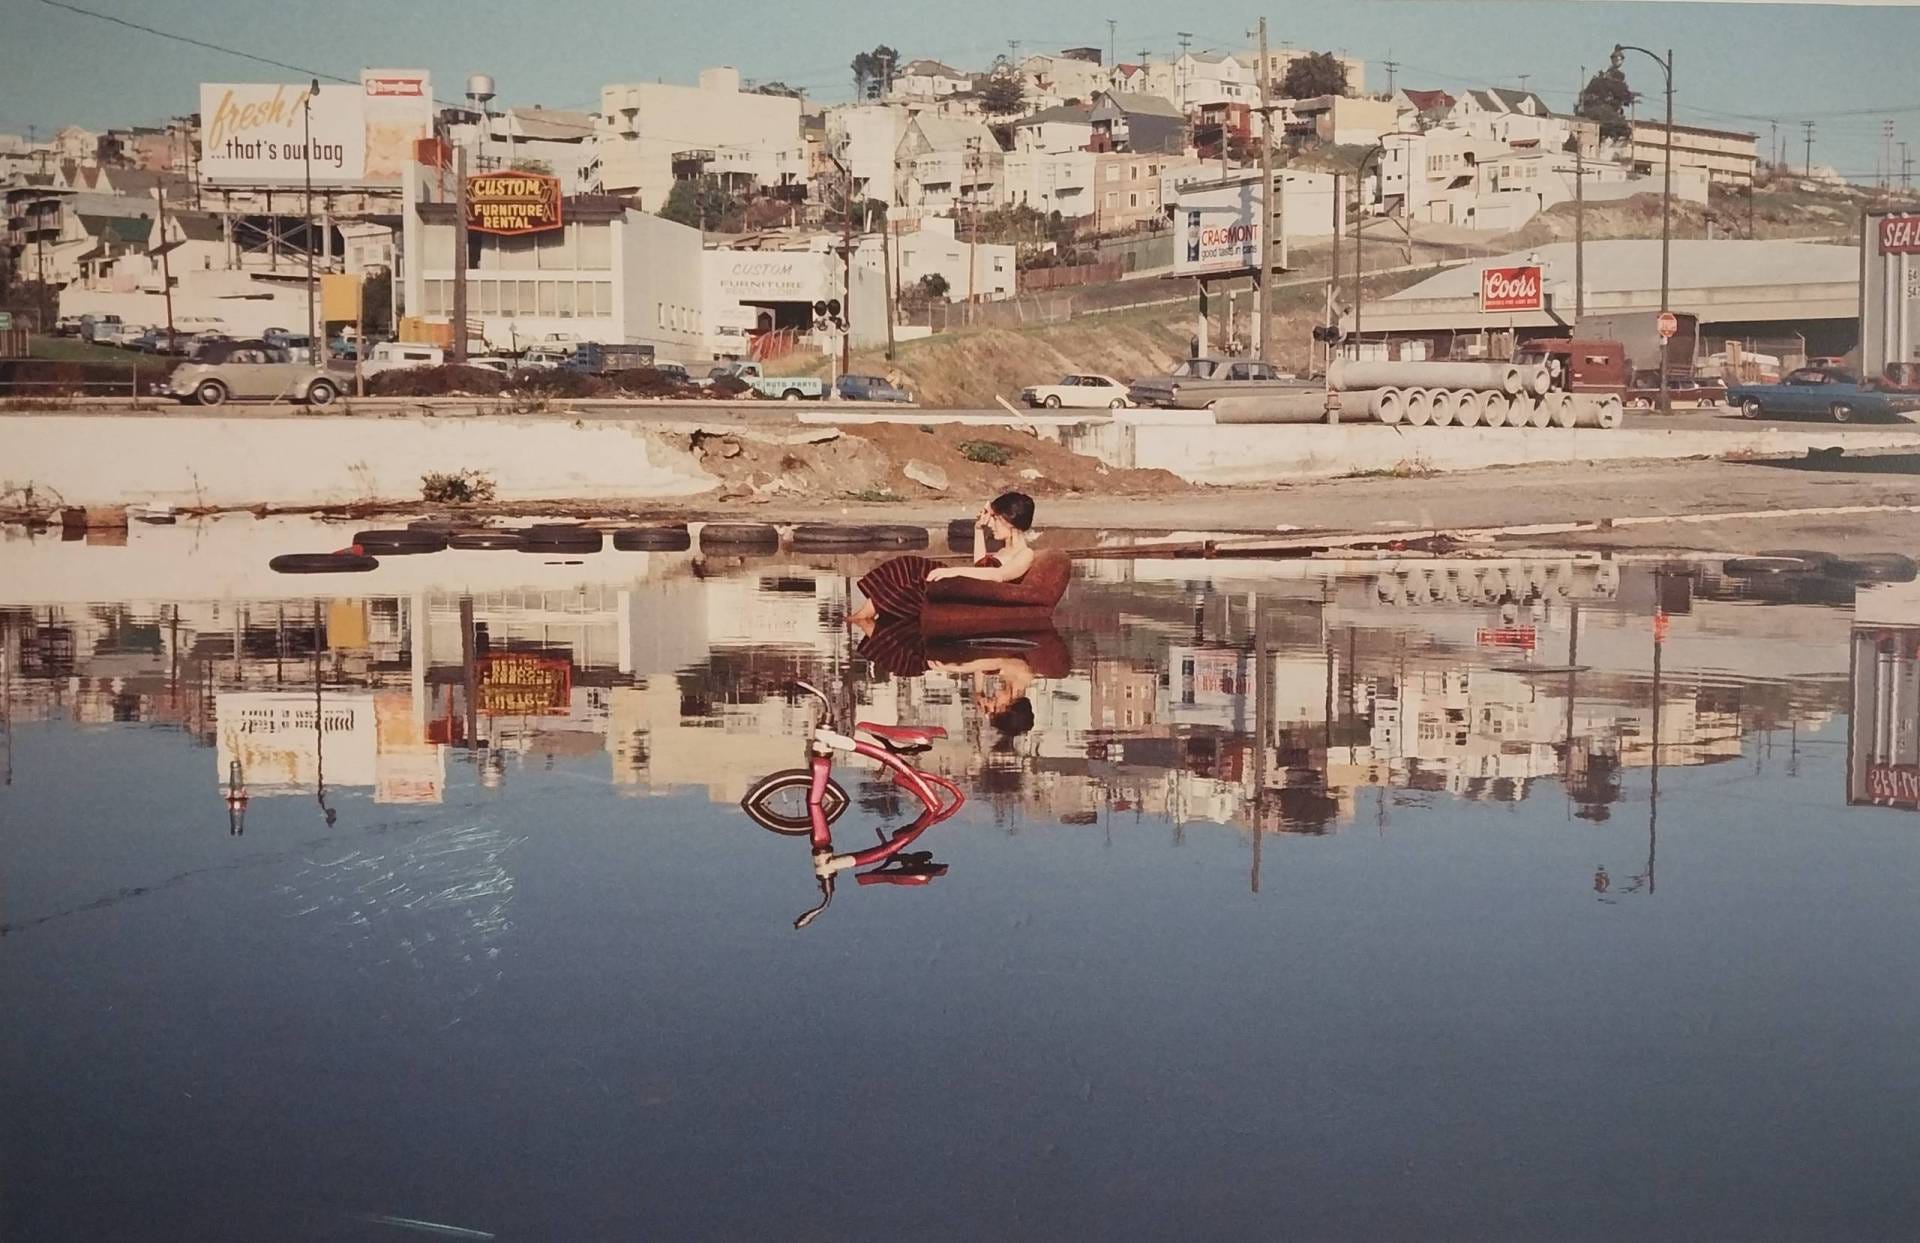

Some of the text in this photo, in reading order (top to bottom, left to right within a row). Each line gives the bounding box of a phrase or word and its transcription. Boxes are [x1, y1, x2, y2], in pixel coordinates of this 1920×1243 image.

[209, 83, 308, 150] fresh!
[312, 137, 343, 168] bag
[474, 179, 541, 196] CUSTOM
[474, 203, 543, 217] FURNITURE
[483, 216, 533, 229] RENTAL
[1201, 224, 1258, 246] CRAGMONT
[1202, 249, 1217, 261] good
[732, 263, 793, 276] CUSTOM
[720, 279, 803, 289] FURNITURE
[1487, 272, 1537, 299] Coors
